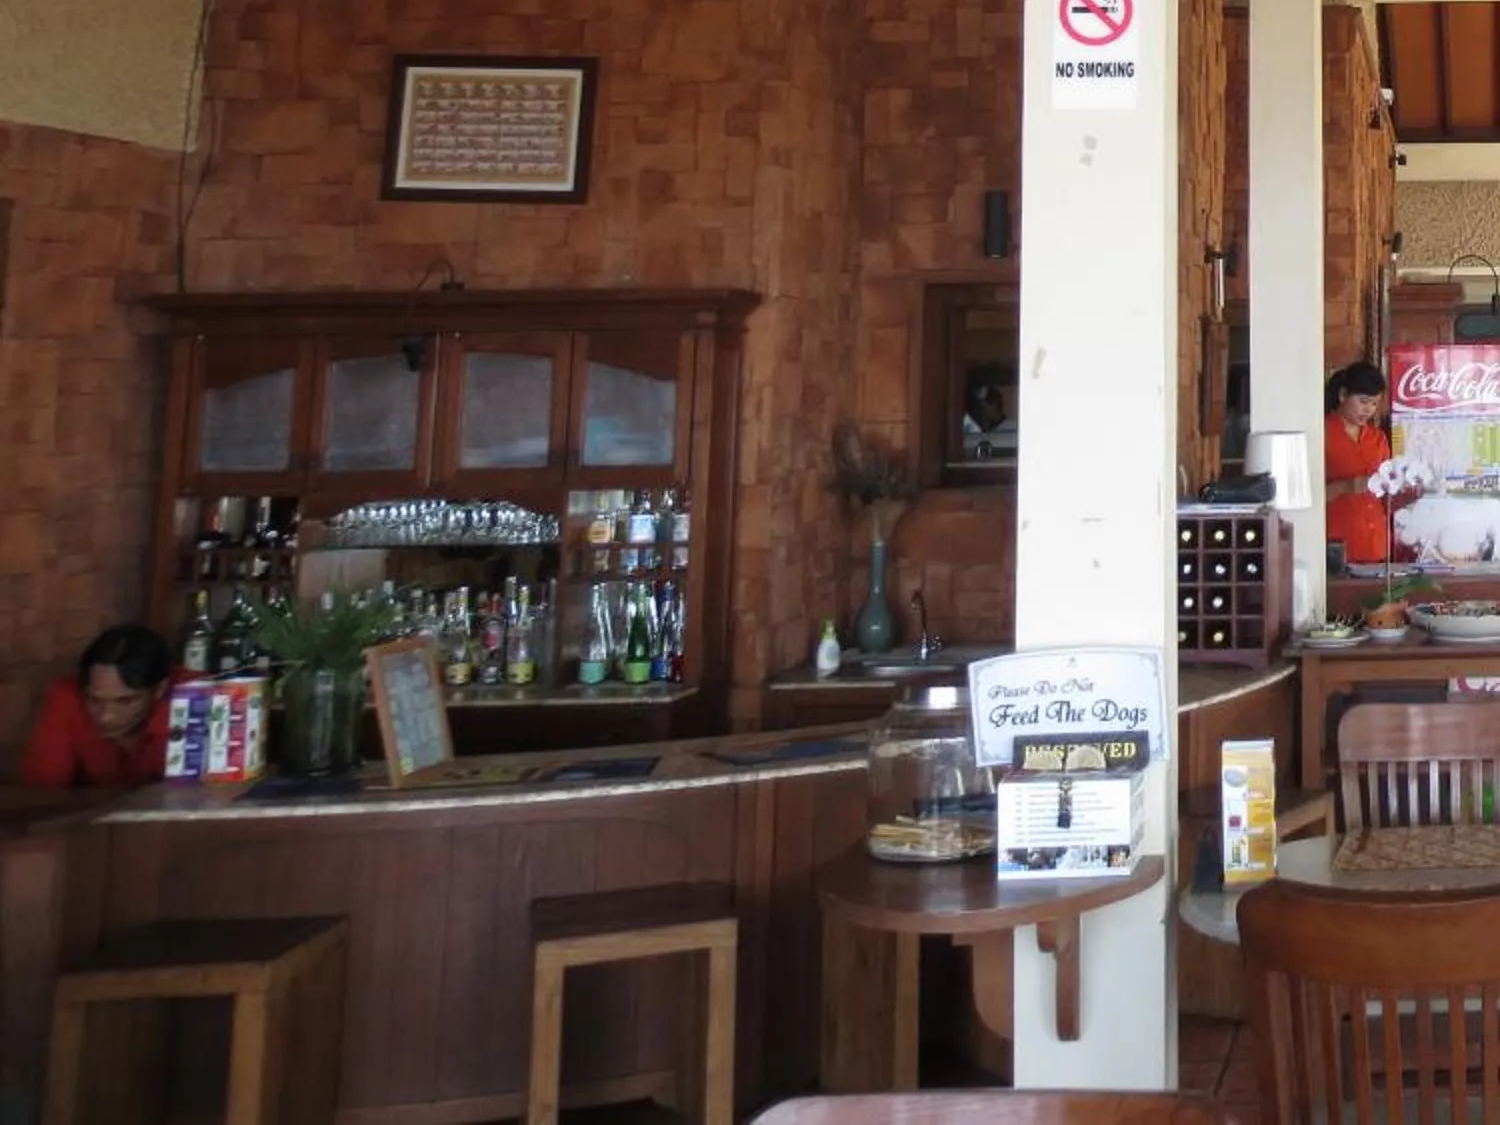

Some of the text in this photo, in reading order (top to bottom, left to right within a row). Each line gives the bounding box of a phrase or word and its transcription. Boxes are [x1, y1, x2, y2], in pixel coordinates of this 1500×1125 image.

[1056, 62, 1135, 78] NO SMOKING
[988, 677, 1096, 700] Please Do Not
[988, 698, 1149, 730] Feed The Dogs
